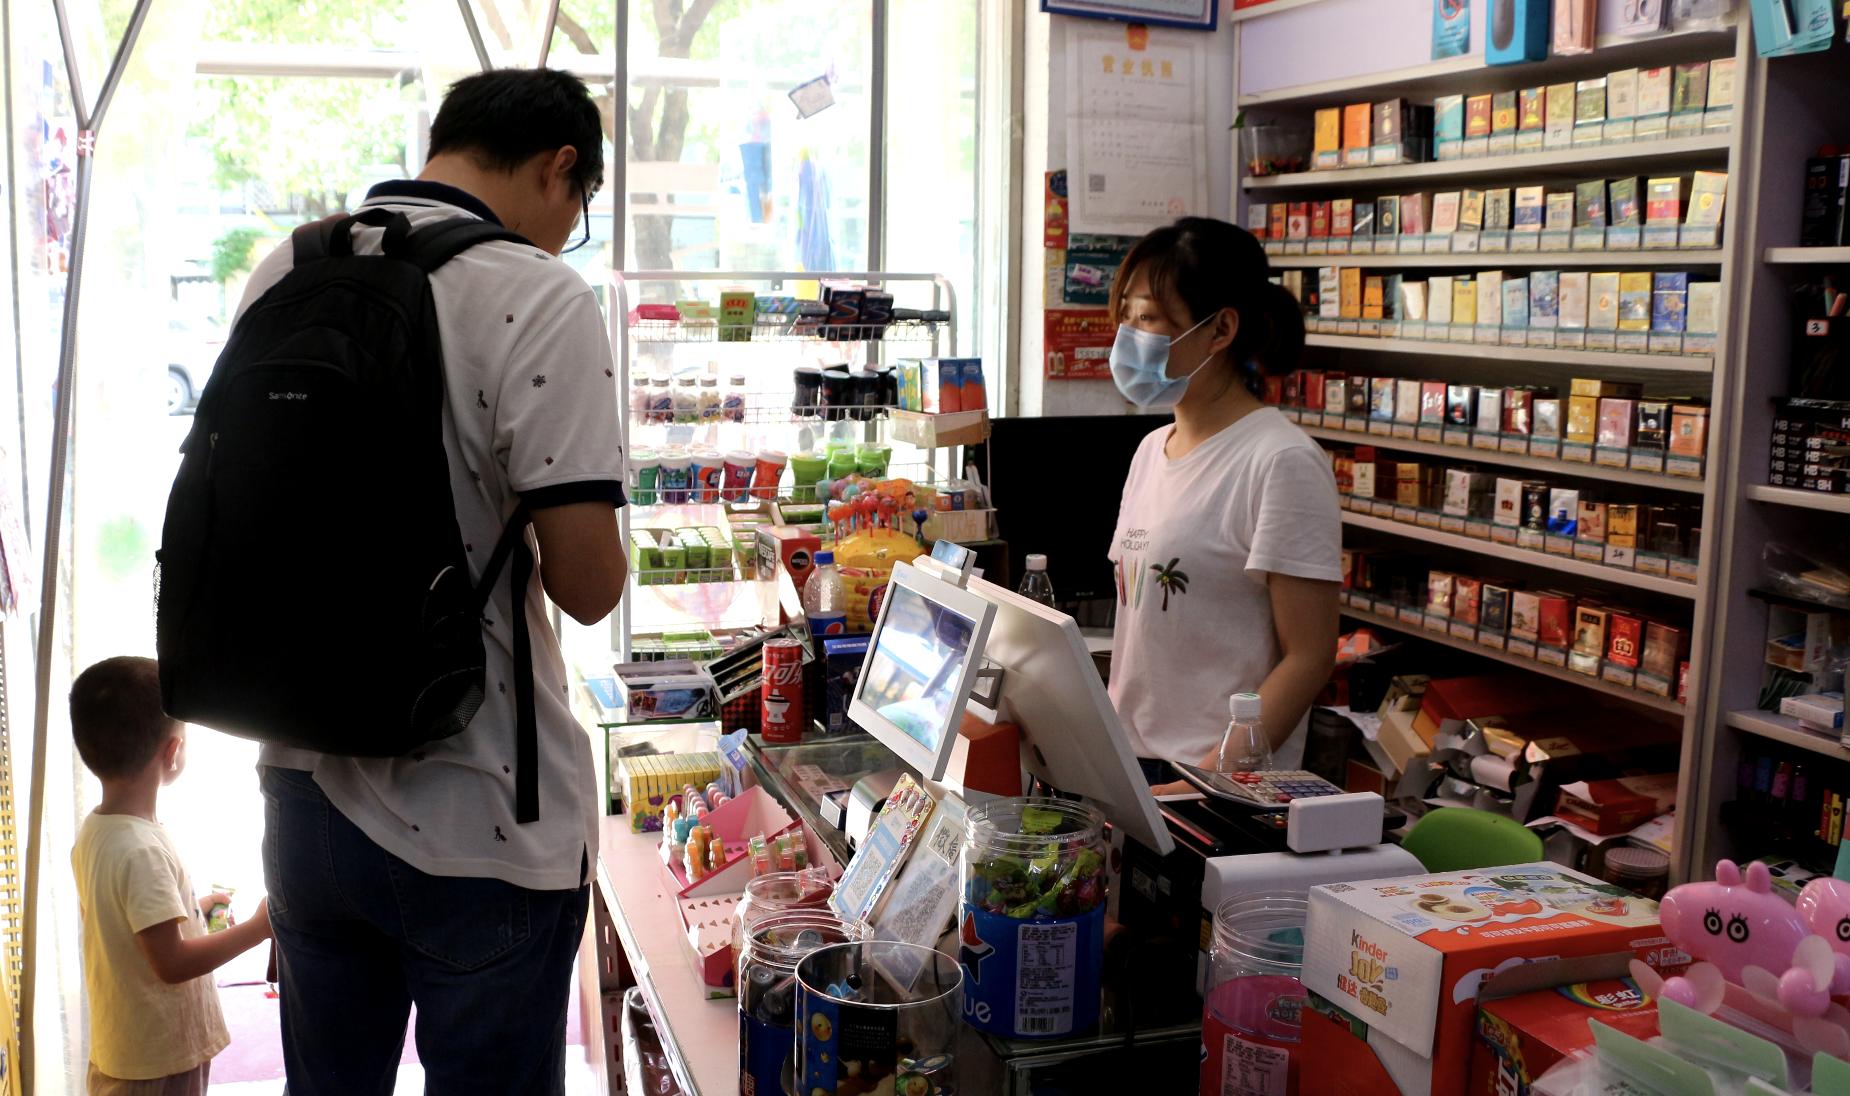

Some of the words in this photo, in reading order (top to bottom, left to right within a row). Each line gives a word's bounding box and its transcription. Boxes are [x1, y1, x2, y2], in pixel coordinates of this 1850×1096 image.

[1775, 420, 1788, 431] HB
[1773, 433, 1786, 445] HB
[1807, 437, 1821, 449] HB
[1772, 446, 1786, 458] HB
[1805, 450, 1820, 462] HB
[1771, 460, 1785, 471] HB
[1804, 464, 1818, 476] HB
[1770, 473, 1783, 484] HB
[1126, 528, 1150, 539] HAPPY
[1351, 929, 1388, 963] Kinder
